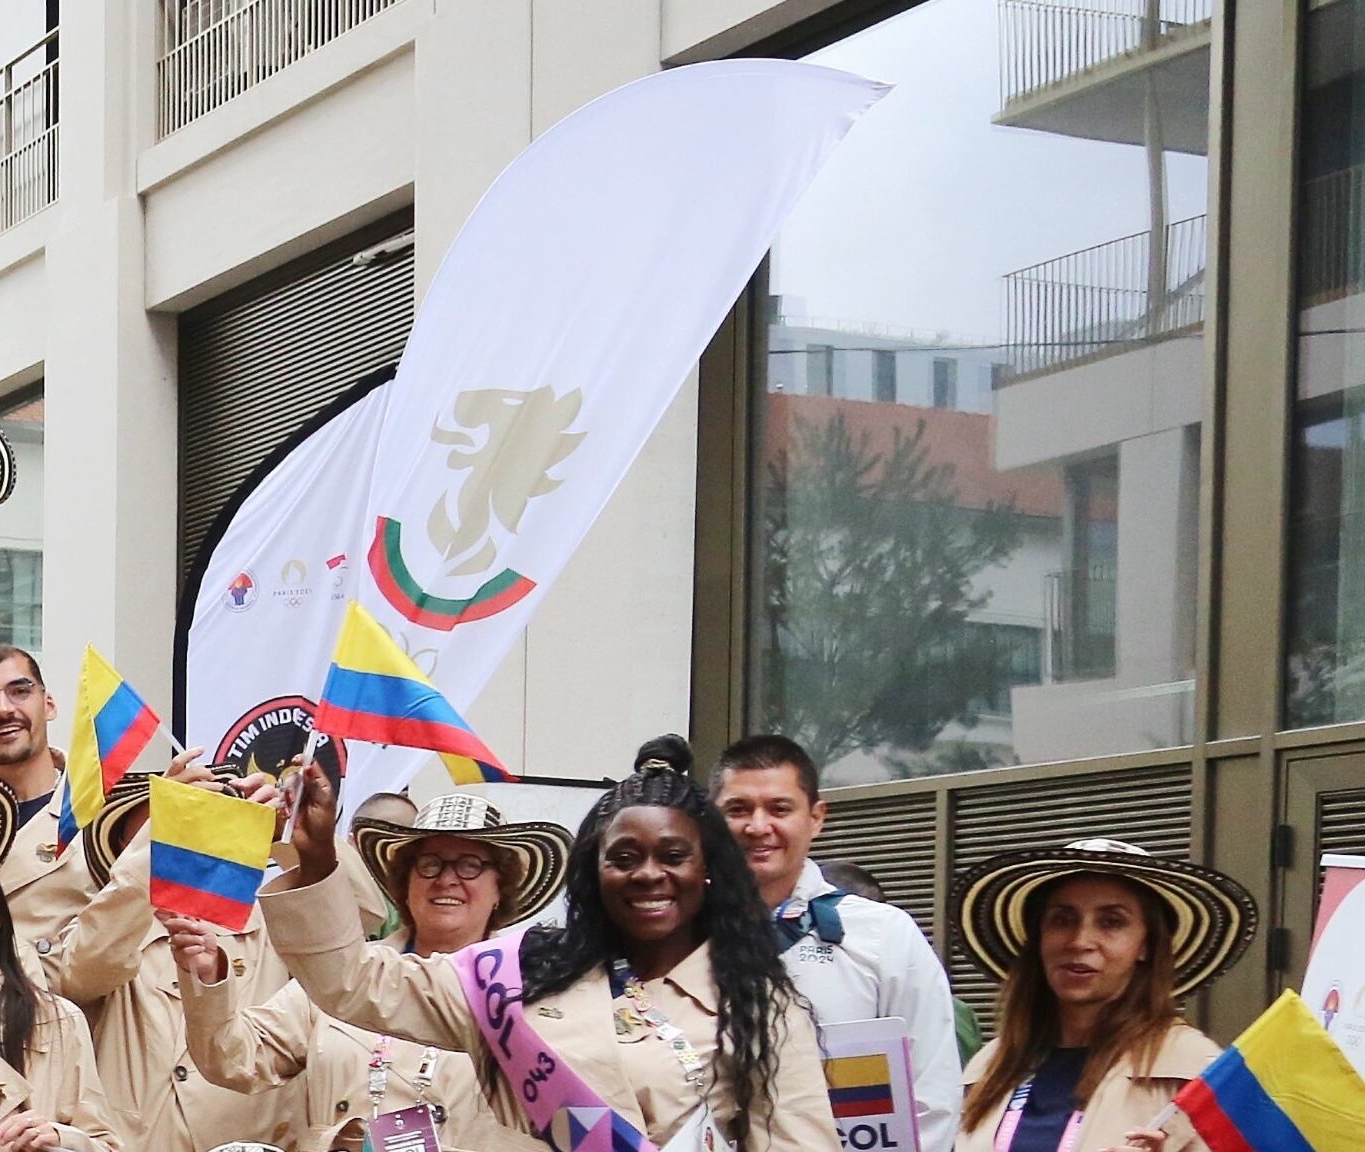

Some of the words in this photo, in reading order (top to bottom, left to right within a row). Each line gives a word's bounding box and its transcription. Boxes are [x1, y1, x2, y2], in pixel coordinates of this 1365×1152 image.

[228, 723, 260, 758] TIM
[799, 953, 833, 964] 2024
[800, 945, 833, 954] PARIS
[474, 949, 514, 1060] COL
[523, 1051, 556, 1102] 043
